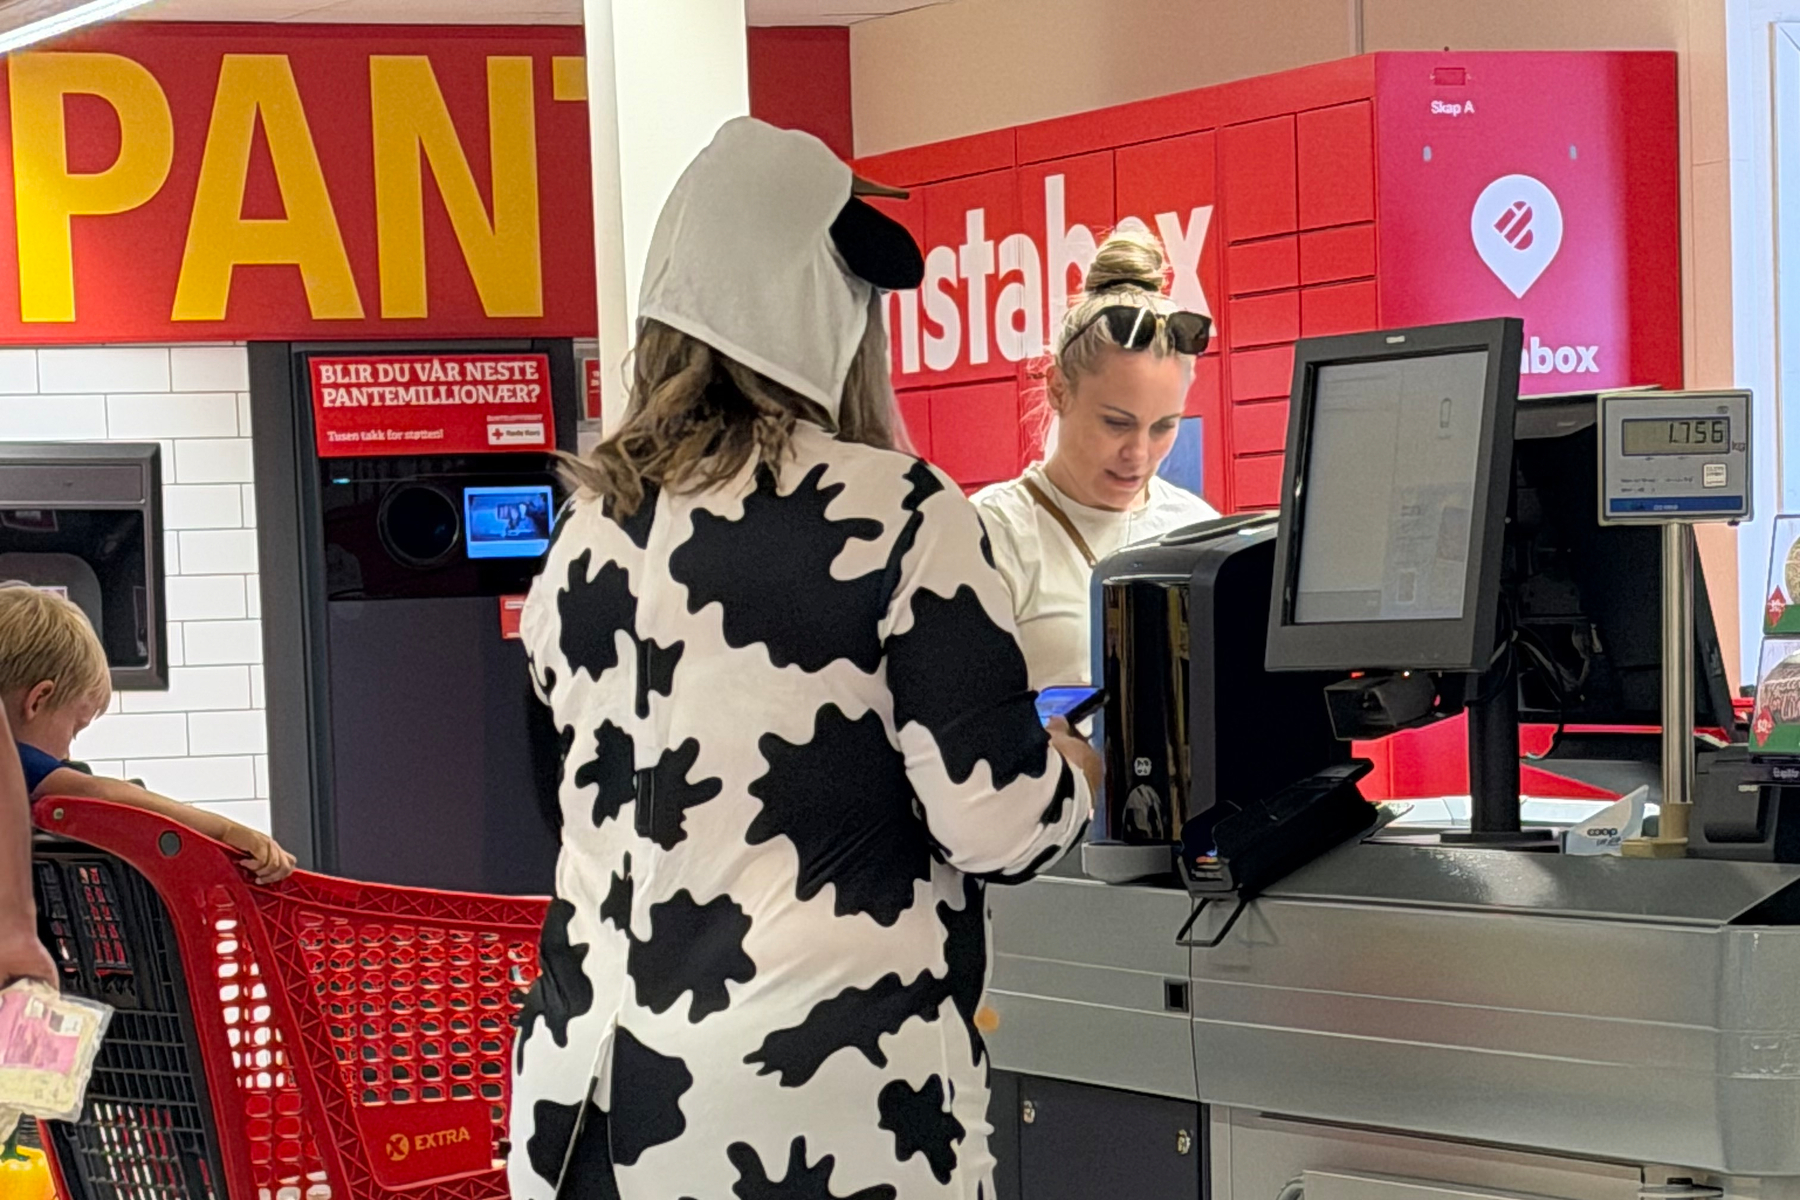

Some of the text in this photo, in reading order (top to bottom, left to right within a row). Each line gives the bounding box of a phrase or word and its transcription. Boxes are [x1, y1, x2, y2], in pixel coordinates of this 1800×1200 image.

[1431, 101, 1475, 116] Skap A
[881, 173, 1217, 374] nstabx
[319, 358, 539, 384] BLIR DU VÅR NESTE
[322, 384, 541, 408] PANTEMILLIONÆR?
[327, 430, 360, 442] Tusen
[361, 429, 385, 441] takk
[387, 428, 403, 440] for
[1669, 421, 1724, 444] 1.756
[1587, 828, 1618, 838] coop
[414, 1126, 471, 1151] EXTRA
